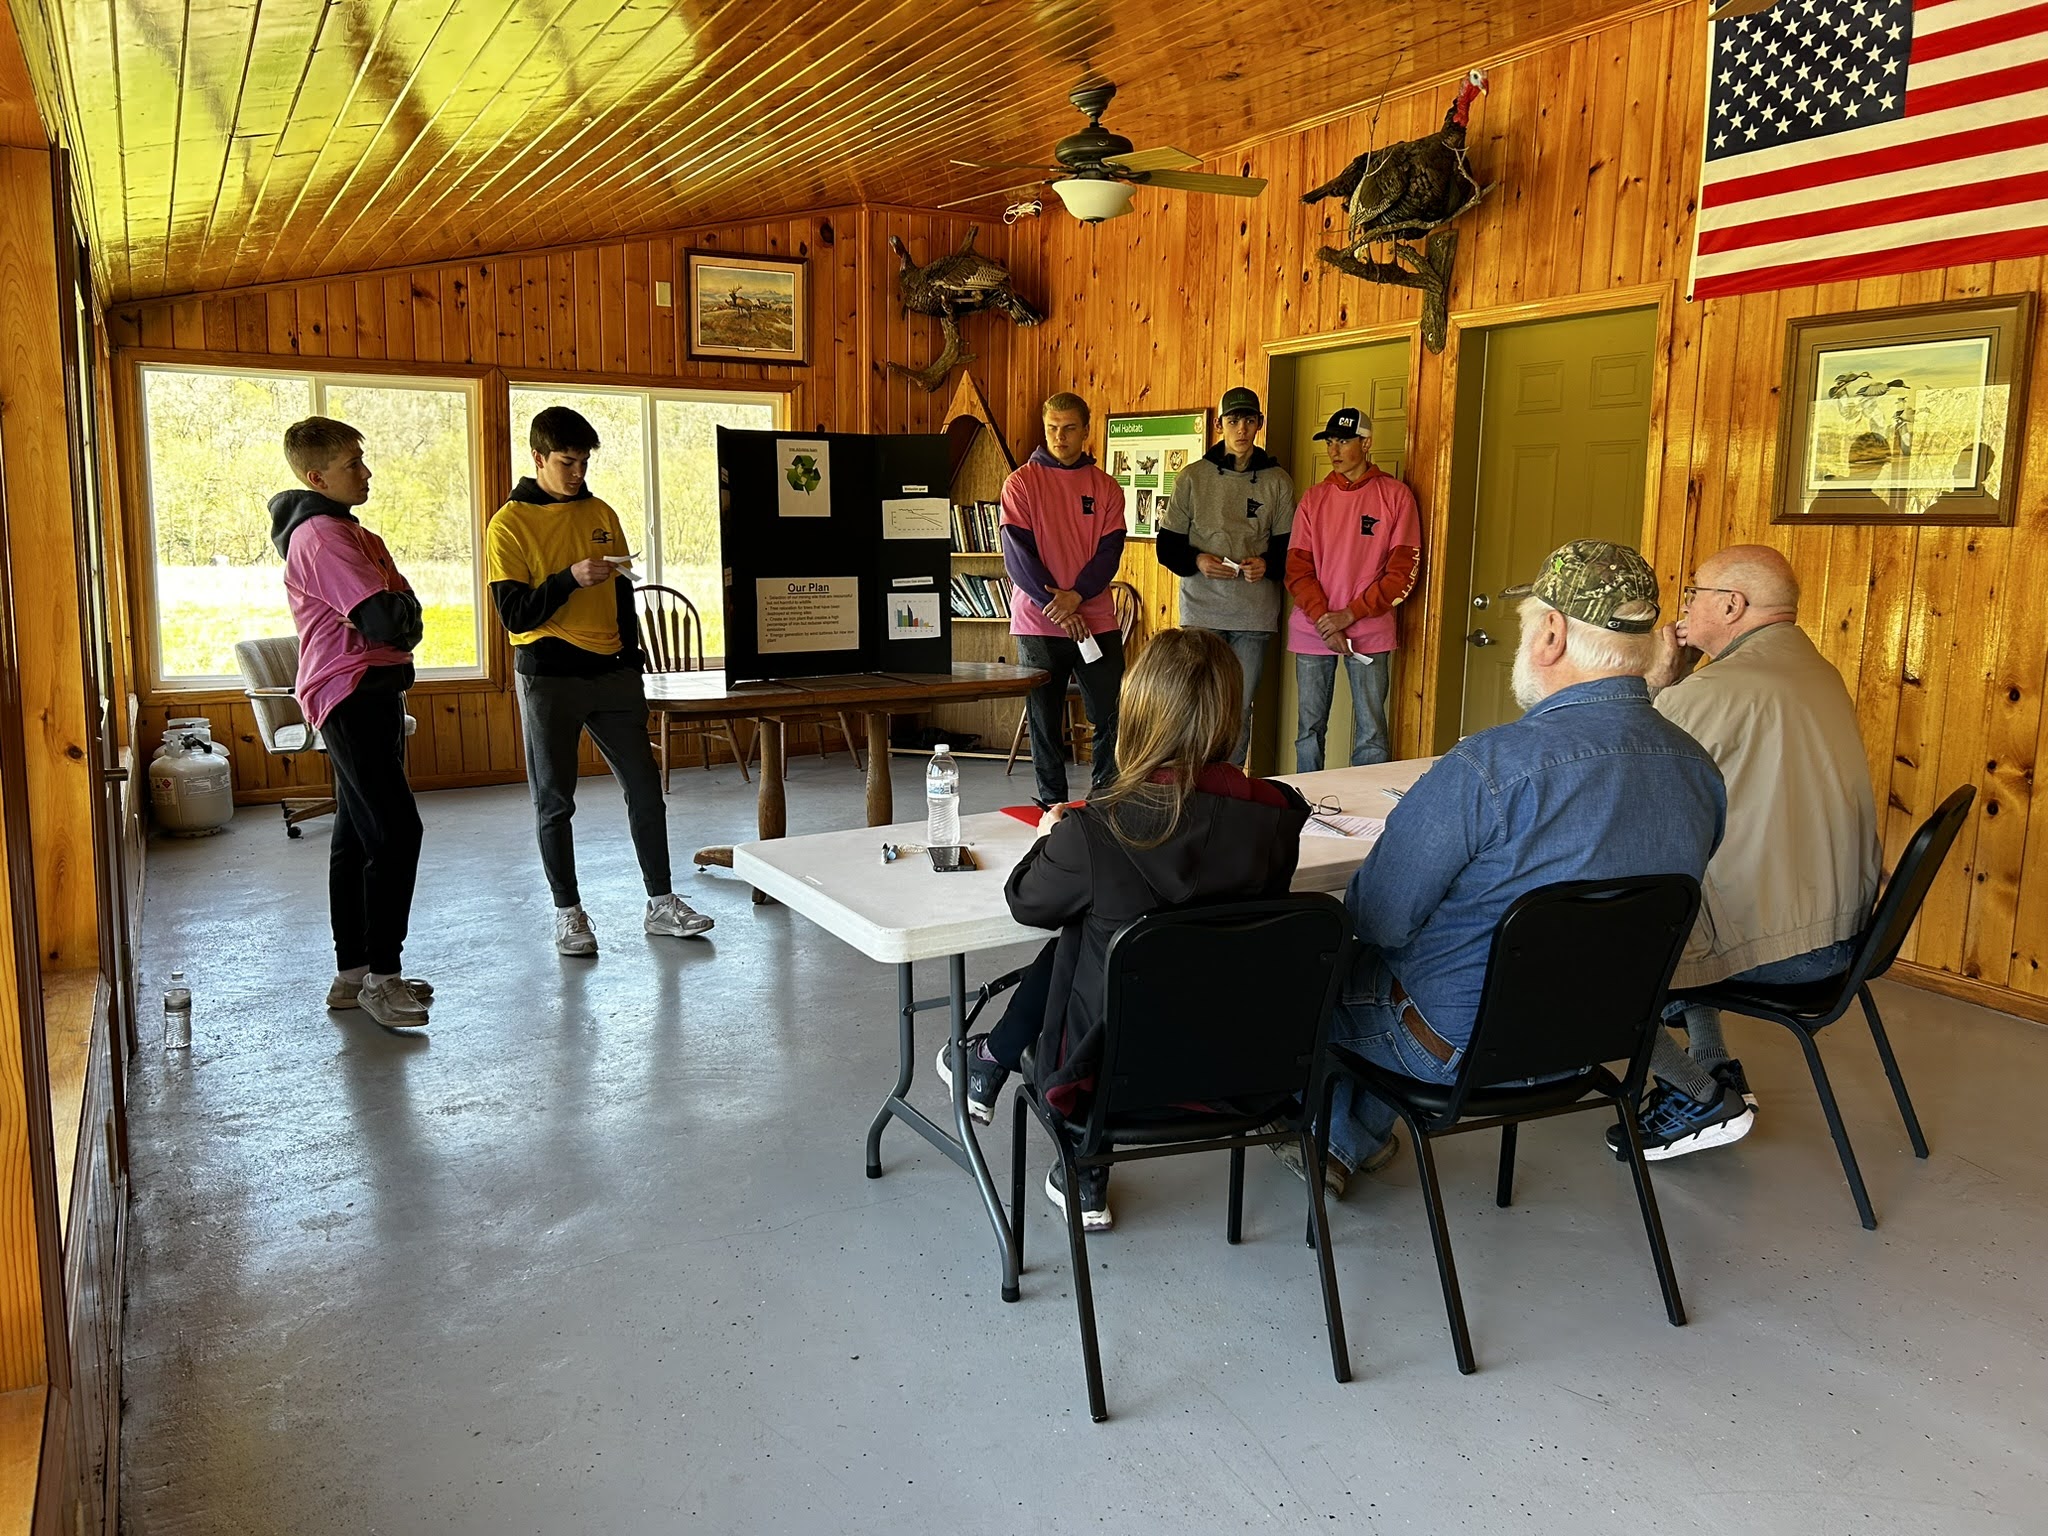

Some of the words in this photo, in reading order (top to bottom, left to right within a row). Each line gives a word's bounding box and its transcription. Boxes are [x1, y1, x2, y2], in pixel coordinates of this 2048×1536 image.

[1338, 417, 1355, 427] CAT
[1110, 424, 1121, 434] Owl
[1121, 423, 1144, 433] Habitats
[788, 583, 806, 592] Our
[808, 583, 829, 592] Plan
